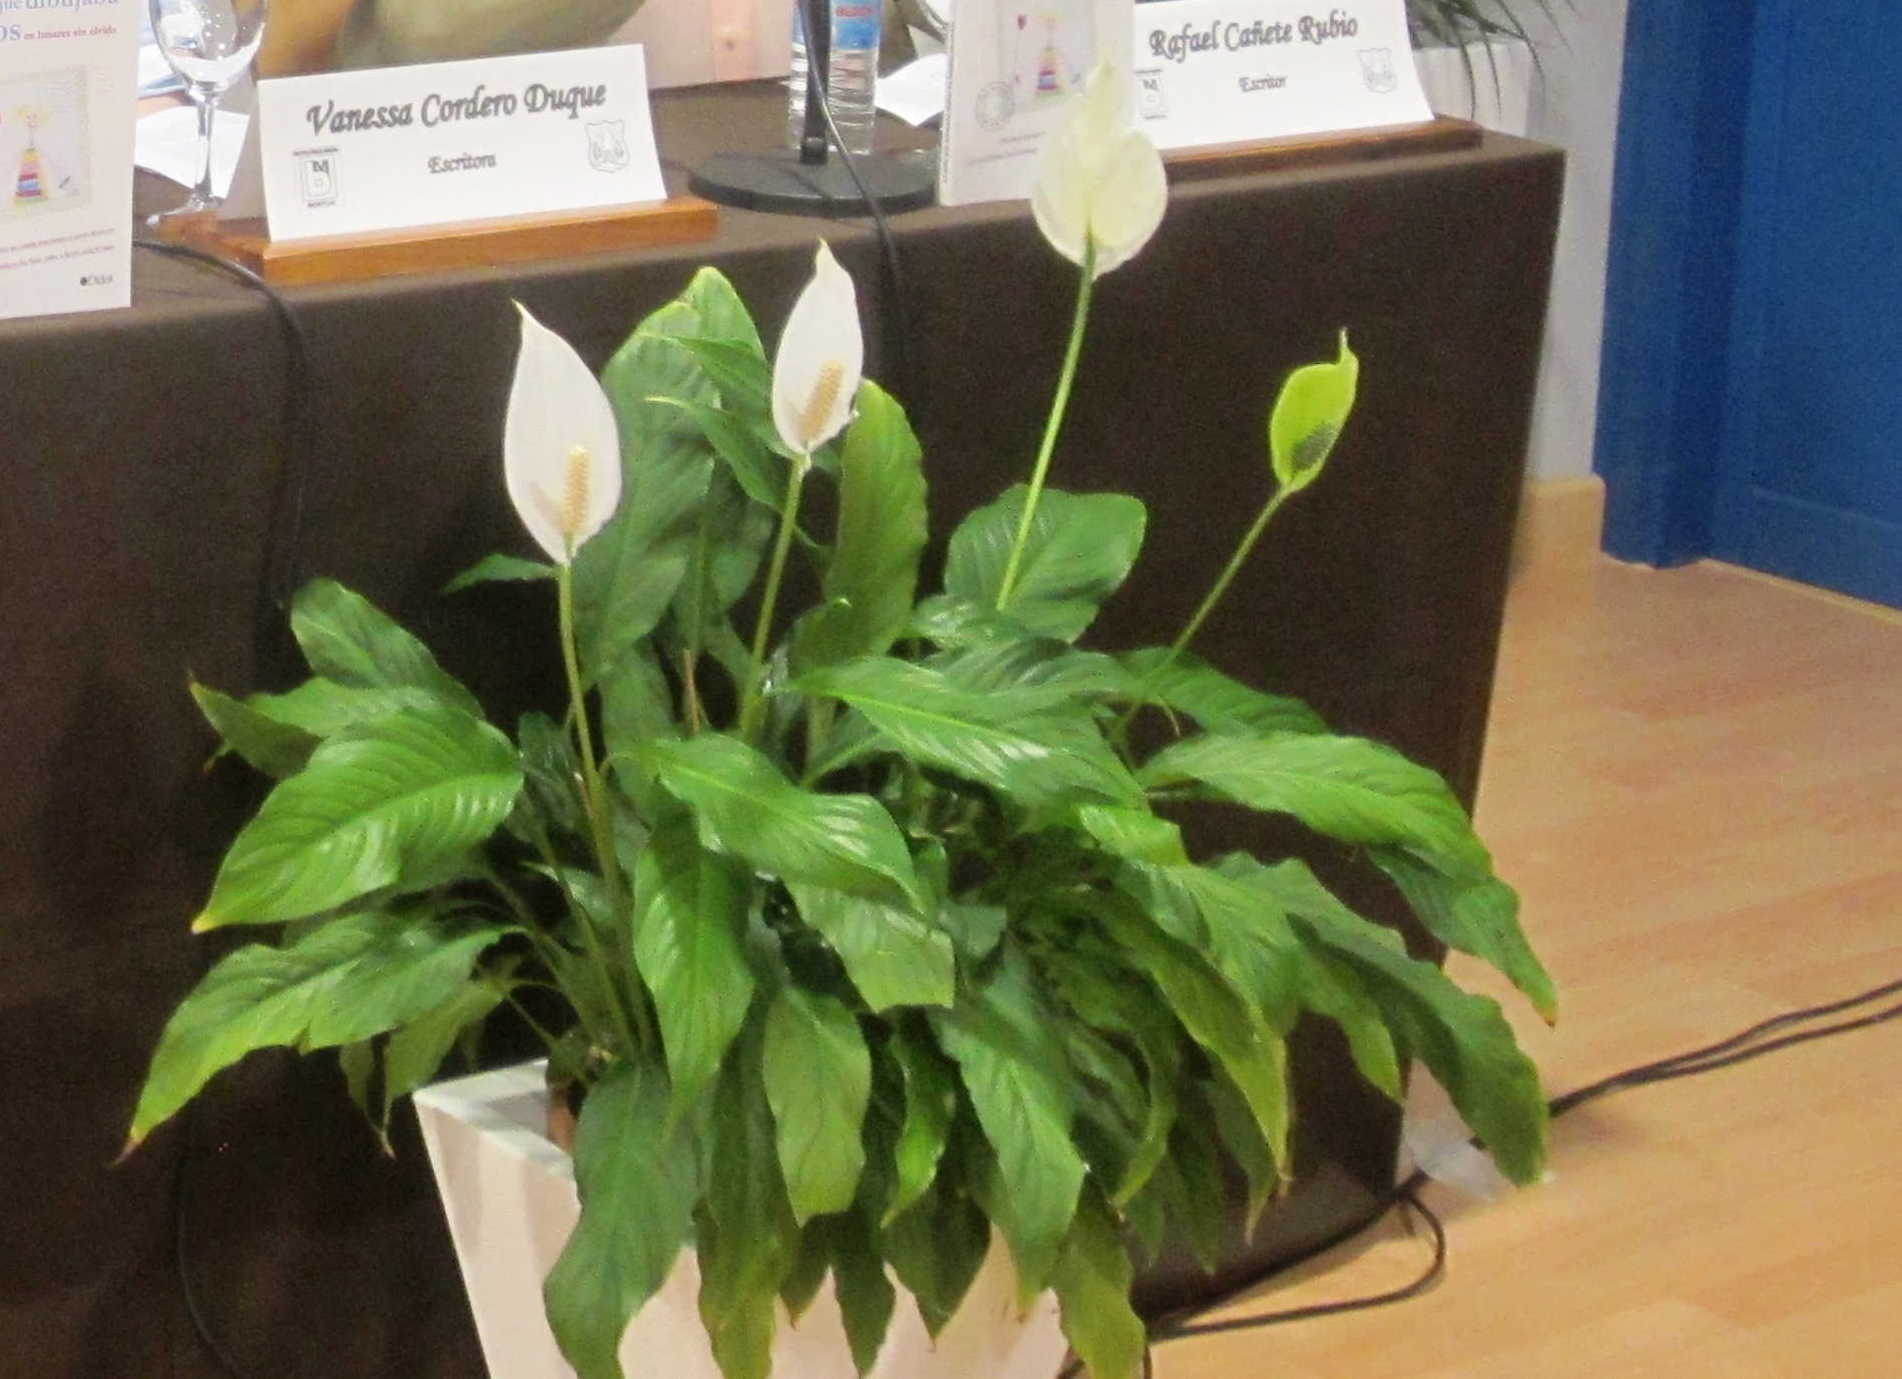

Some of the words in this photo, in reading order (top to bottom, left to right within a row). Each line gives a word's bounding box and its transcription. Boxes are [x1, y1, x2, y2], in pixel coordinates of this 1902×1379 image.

[1148, 20, 1221, 64] Rafael
[1224, 20, 1293, 52] Cañete
[1297, 8, 1358, 45] Rubio
[1239, 74, 1288, 92] Escritor
[306, 99, 414, 137] Vanessa
[420, 84, 518, 128] Cordero
[524, 83, 607, 120] Duque
[428, 153, 498, 174] Escritora
